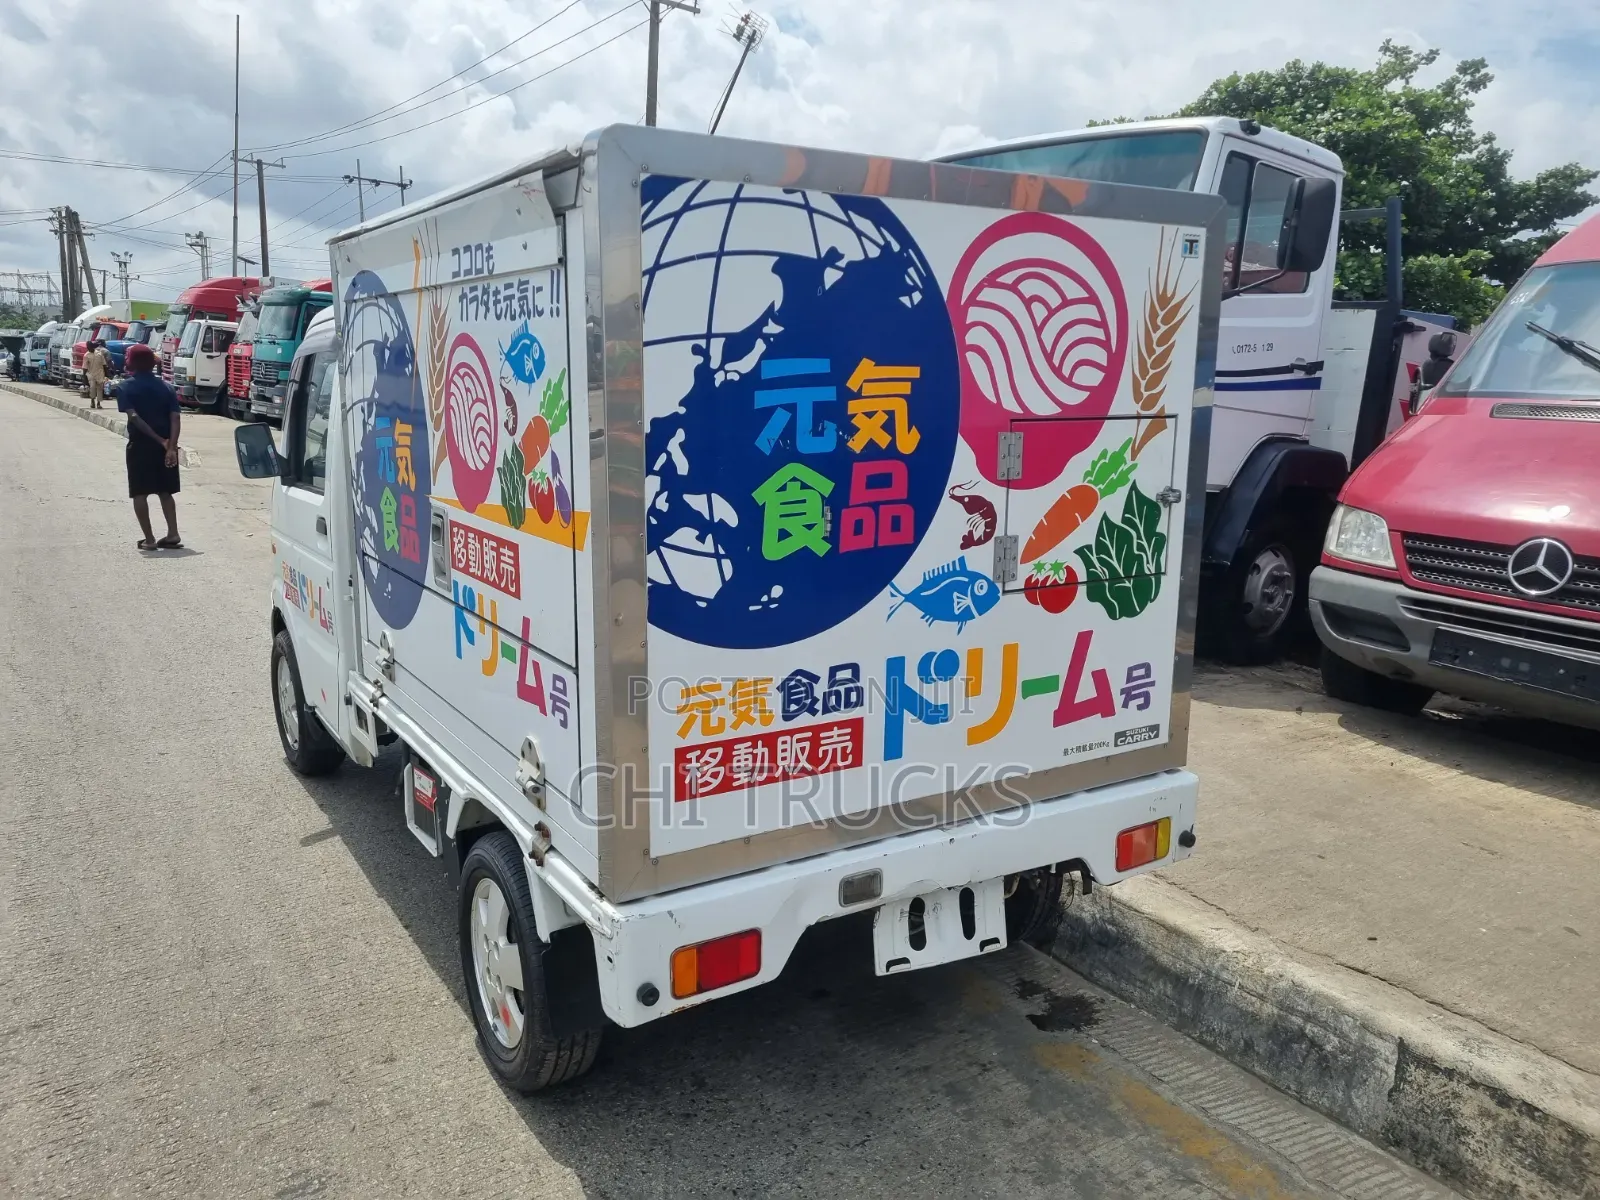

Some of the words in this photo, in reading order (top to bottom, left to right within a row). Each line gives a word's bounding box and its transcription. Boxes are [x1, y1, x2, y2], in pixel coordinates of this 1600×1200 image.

[451, 242, 495, 279] ココロも
[754, 357, 921, 456] 元気
[375, 416, 416, 492] 元気
[379, 486, 421, 564] 食品
[751, 459, 915, 561] 食品
[452, 526, 517, 593] 移動販売
[453, 577, 571, 730] ドリーム号
[676, 661, 865, 740] 元気食品
[883, 629, 1156, 762] ドリーム号
[1125, 726, 1150, 736] SUZUKI
[684, 725, 853, 795] 移動販売
[1116, 730, 1158, 746] CARRY
